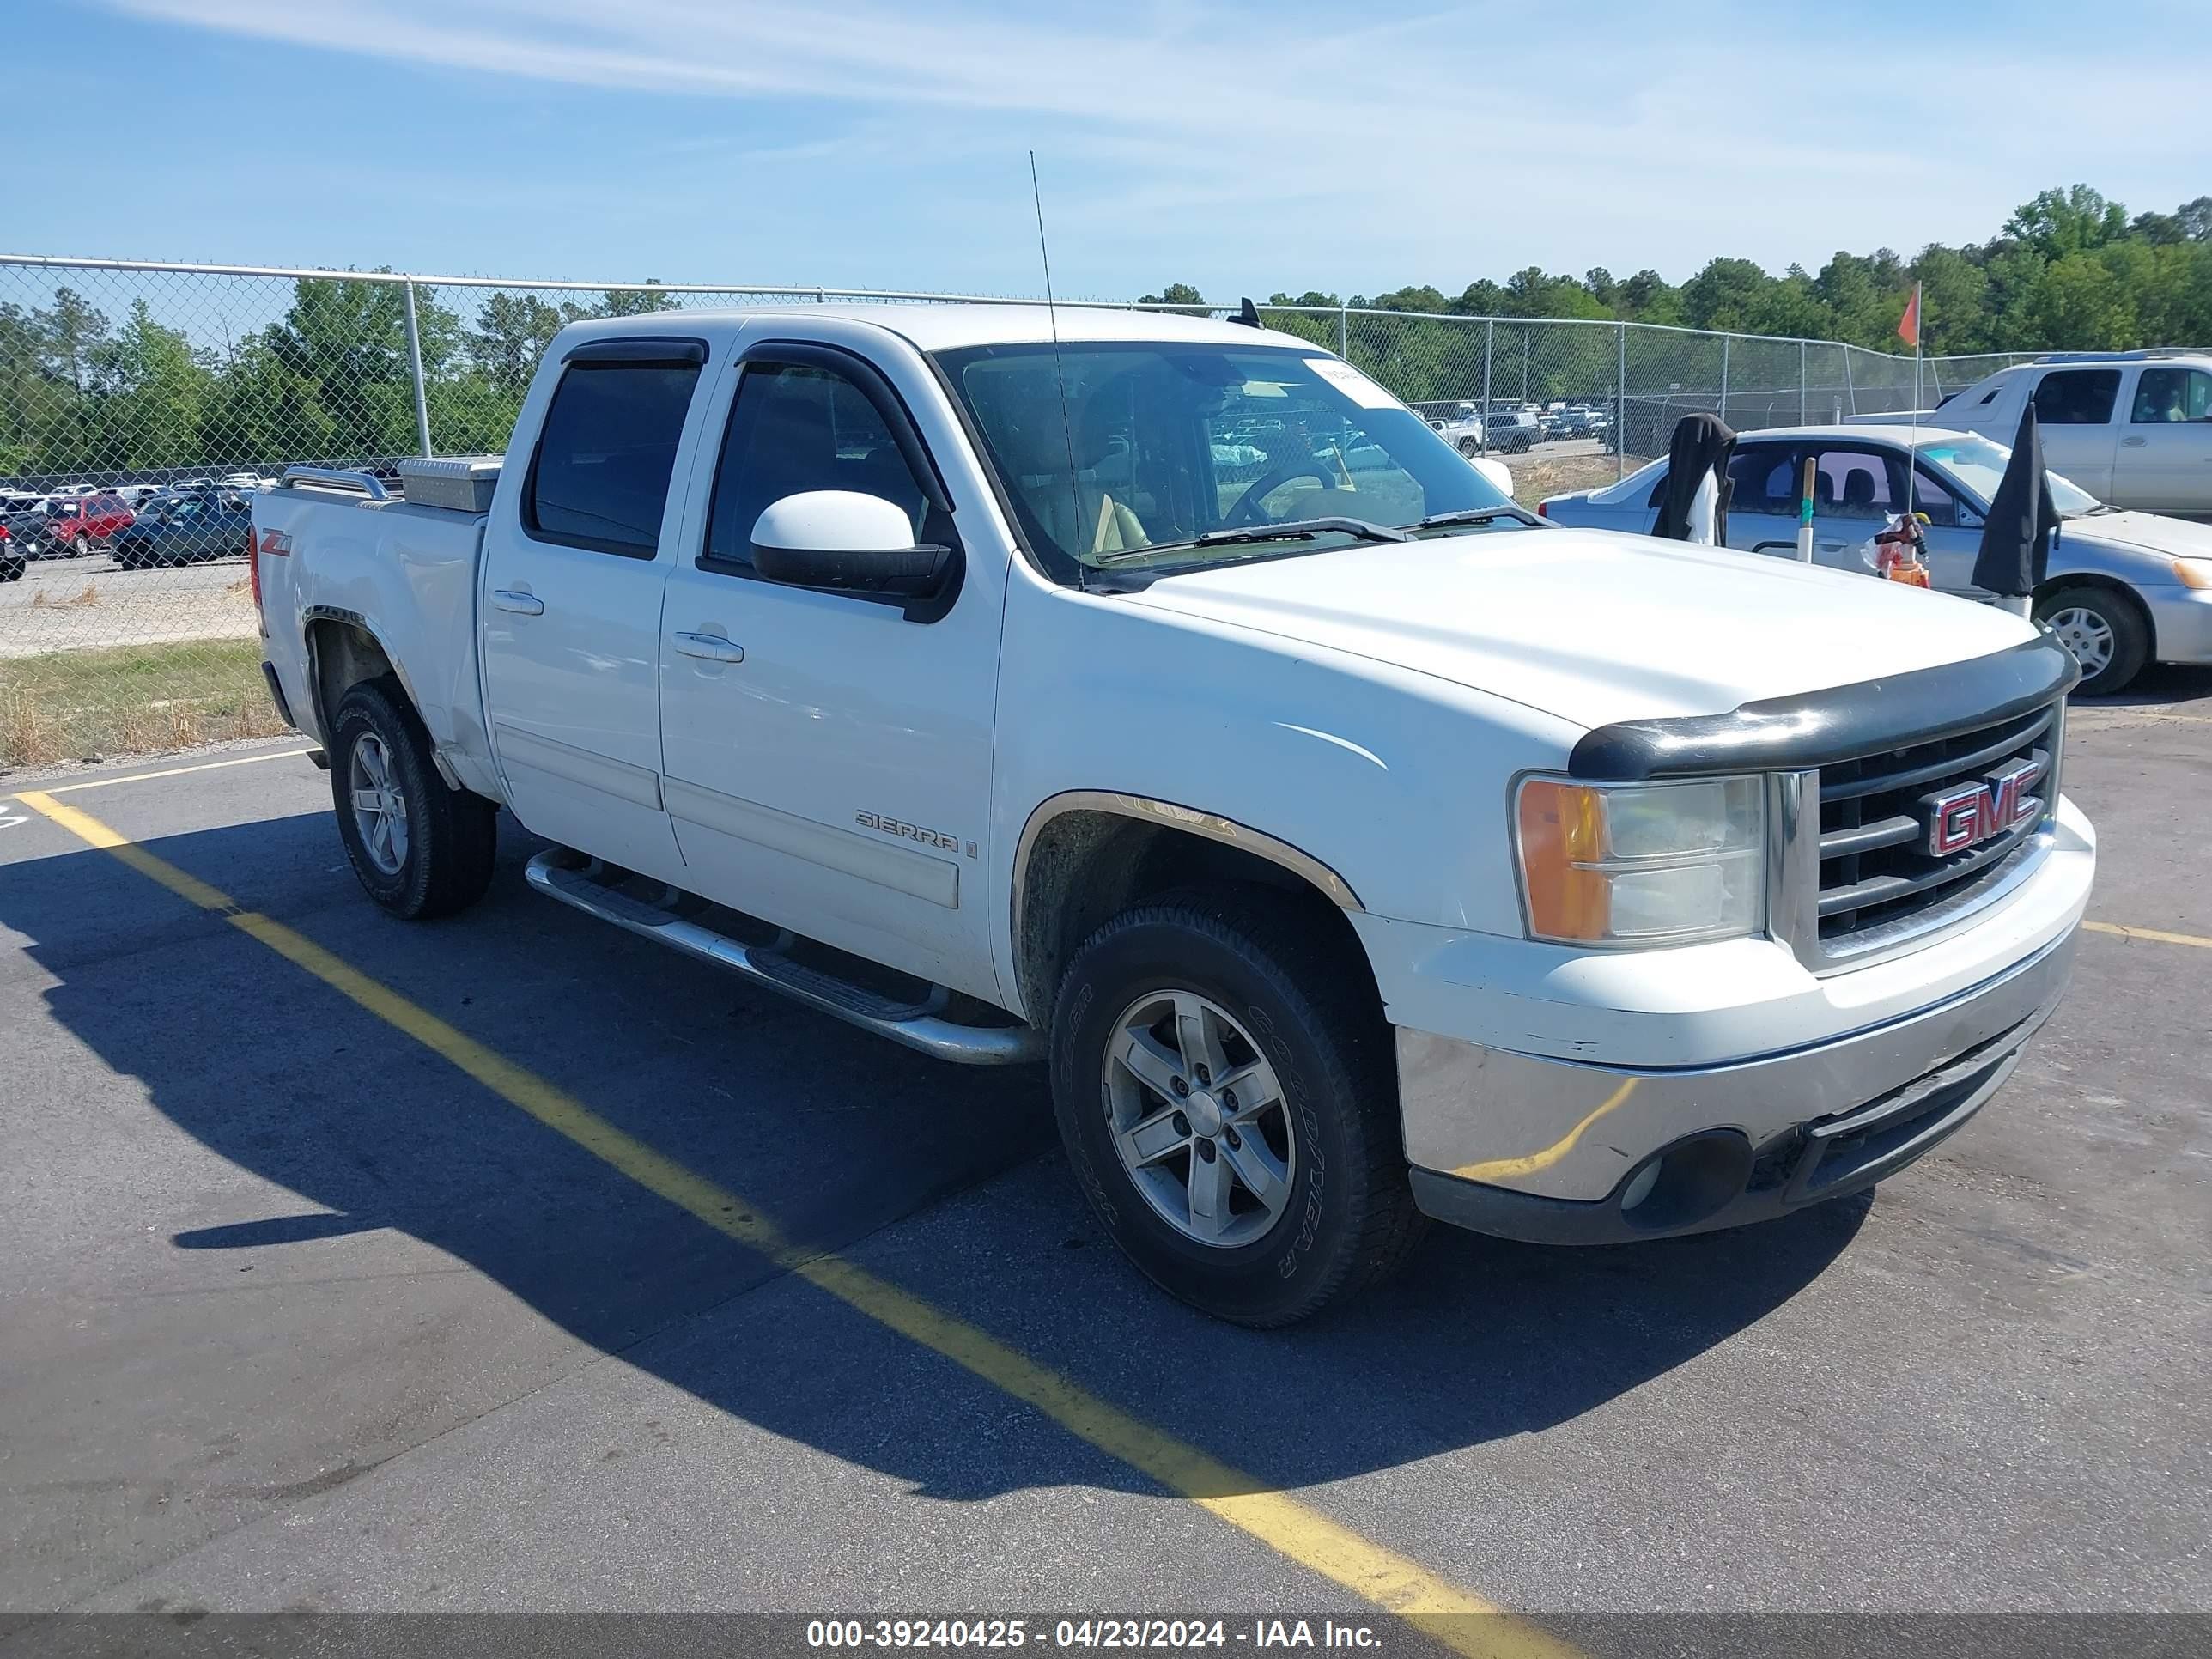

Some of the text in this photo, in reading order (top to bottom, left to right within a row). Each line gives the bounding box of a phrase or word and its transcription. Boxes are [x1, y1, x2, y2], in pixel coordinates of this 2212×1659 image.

[855, 809, 959, 854] SIERRA
[1929, 762, 2039, 857] GMC
[1248, 1004, 1326, 1279] GOODYEAR
